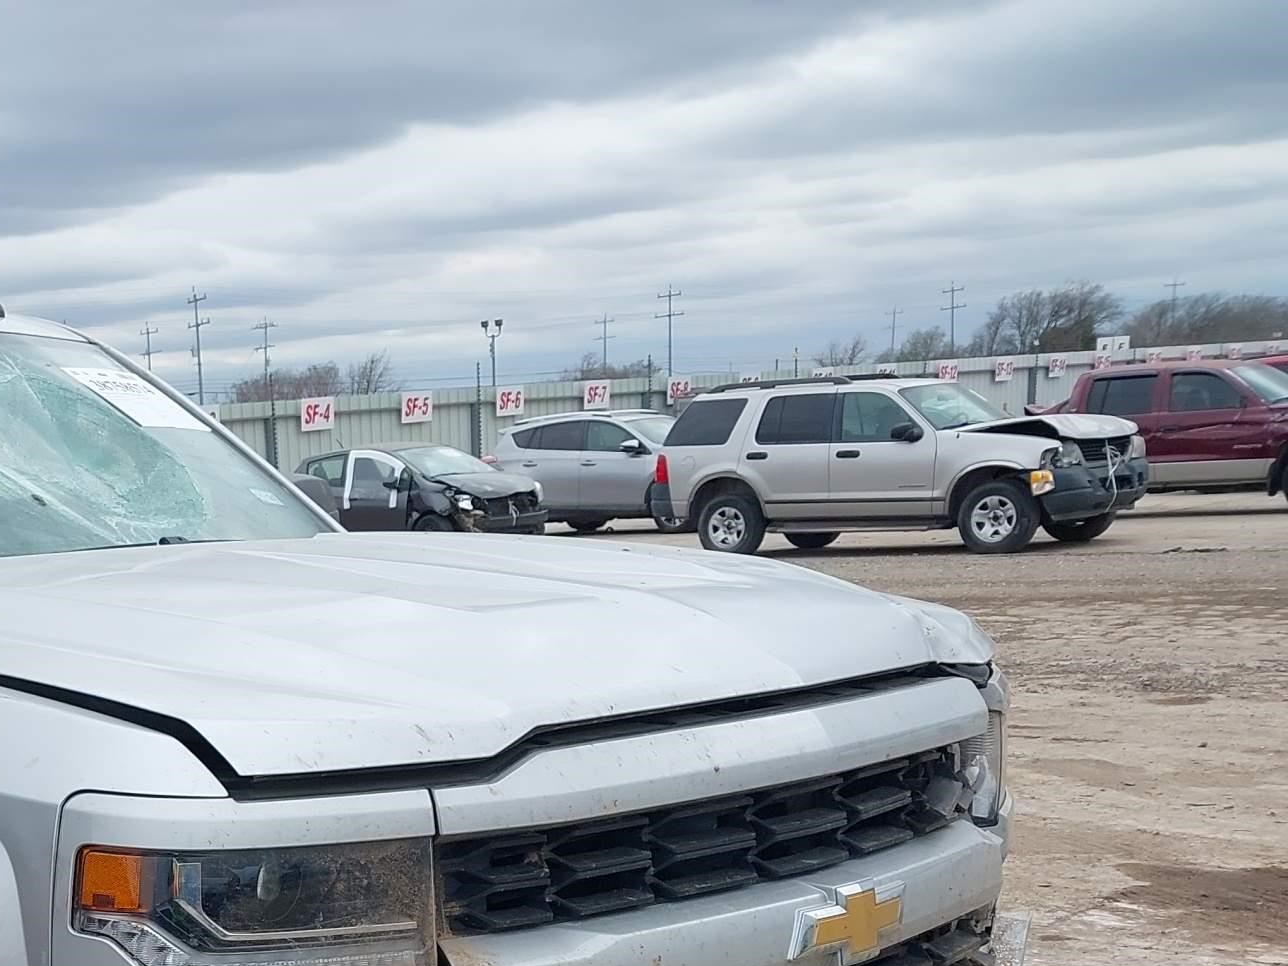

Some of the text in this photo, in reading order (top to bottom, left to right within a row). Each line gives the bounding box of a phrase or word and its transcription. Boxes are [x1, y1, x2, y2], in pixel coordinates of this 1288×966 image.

[499, 391, 522, 410] SF-6
[586, 385, 608, 404] SF-7
[304, 403, 331, 424] SF-4
[404, 397, 430, 417] SF-5
